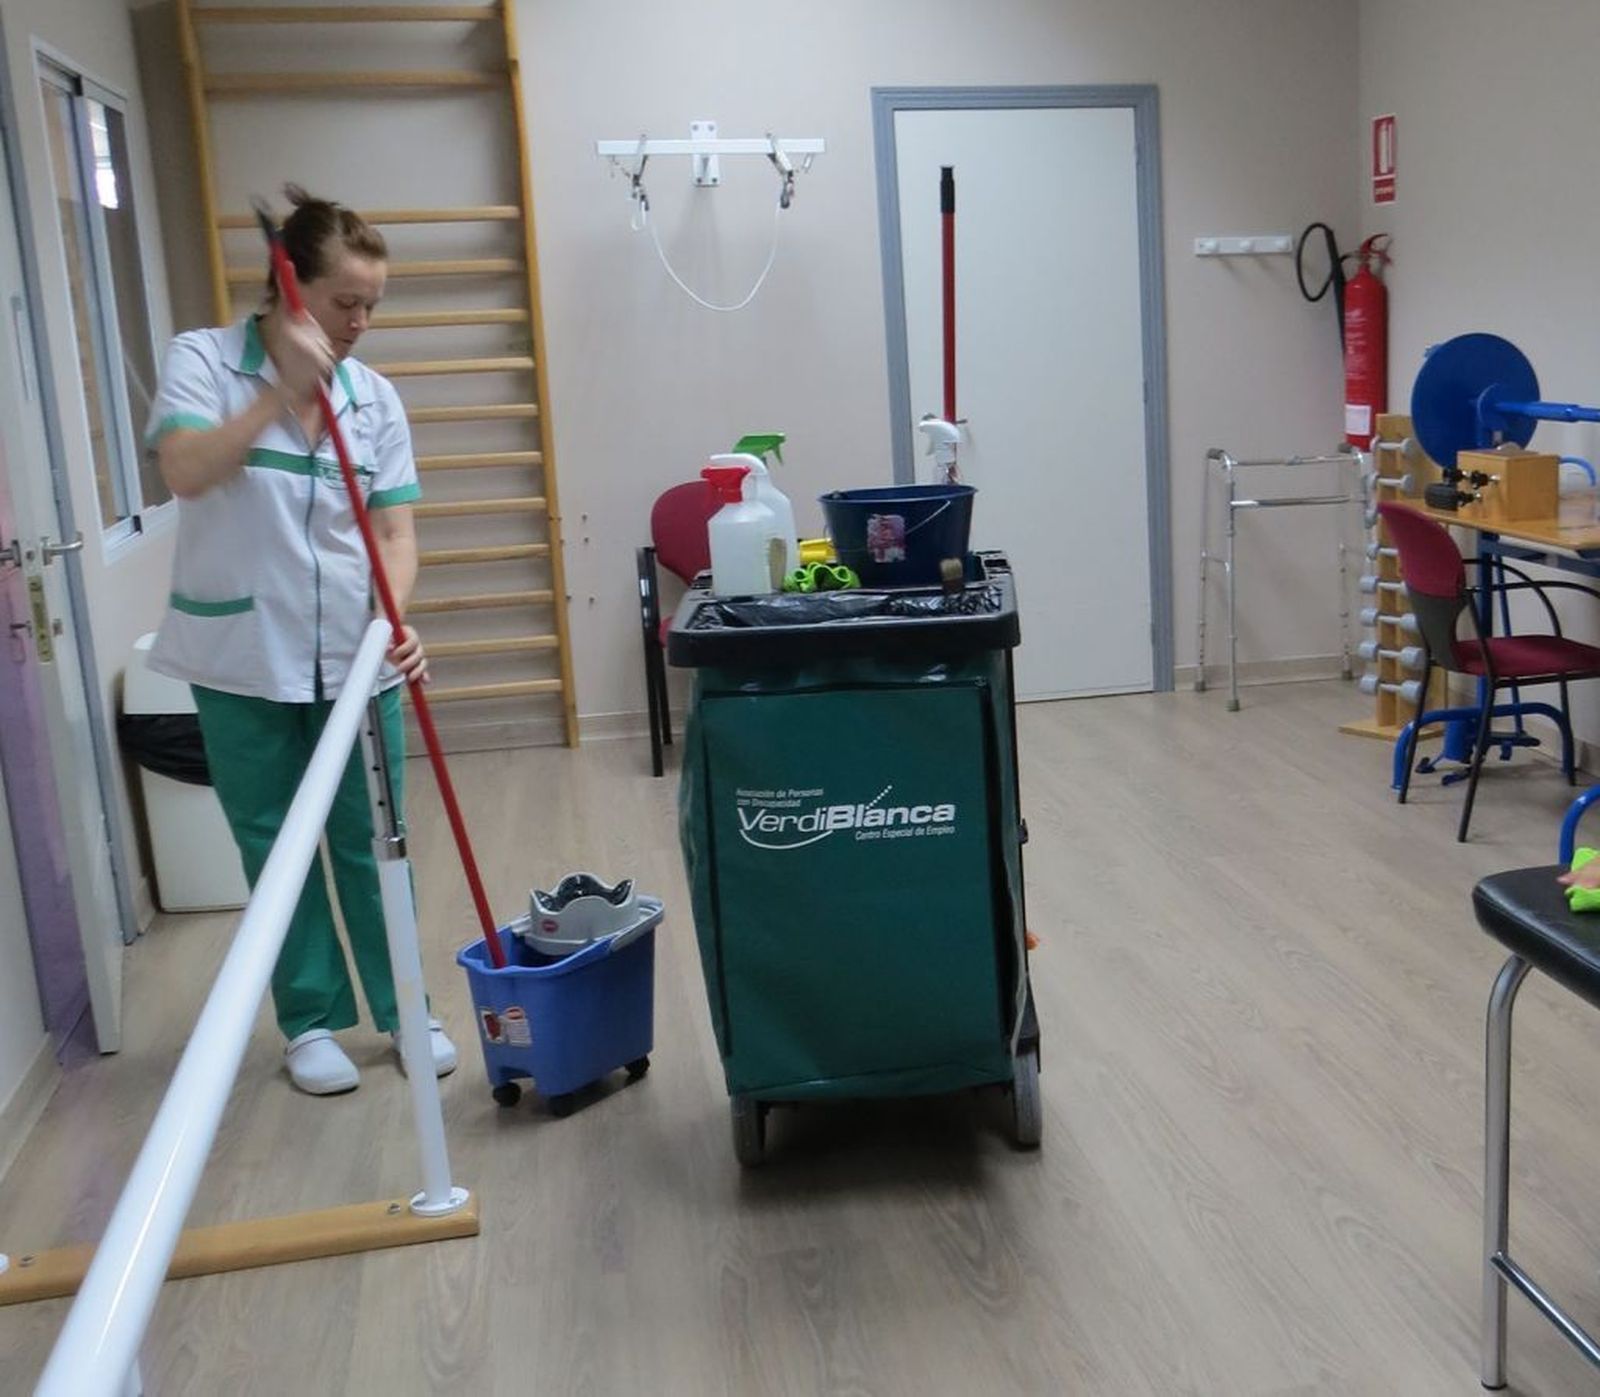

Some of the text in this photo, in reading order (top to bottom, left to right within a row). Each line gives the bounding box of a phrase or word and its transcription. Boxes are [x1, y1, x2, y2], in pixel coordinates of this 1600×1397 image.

[737, 804, 955, 832] VerdiBlanca
[855, 825, 956, 841] Centro Especial de Empleo
